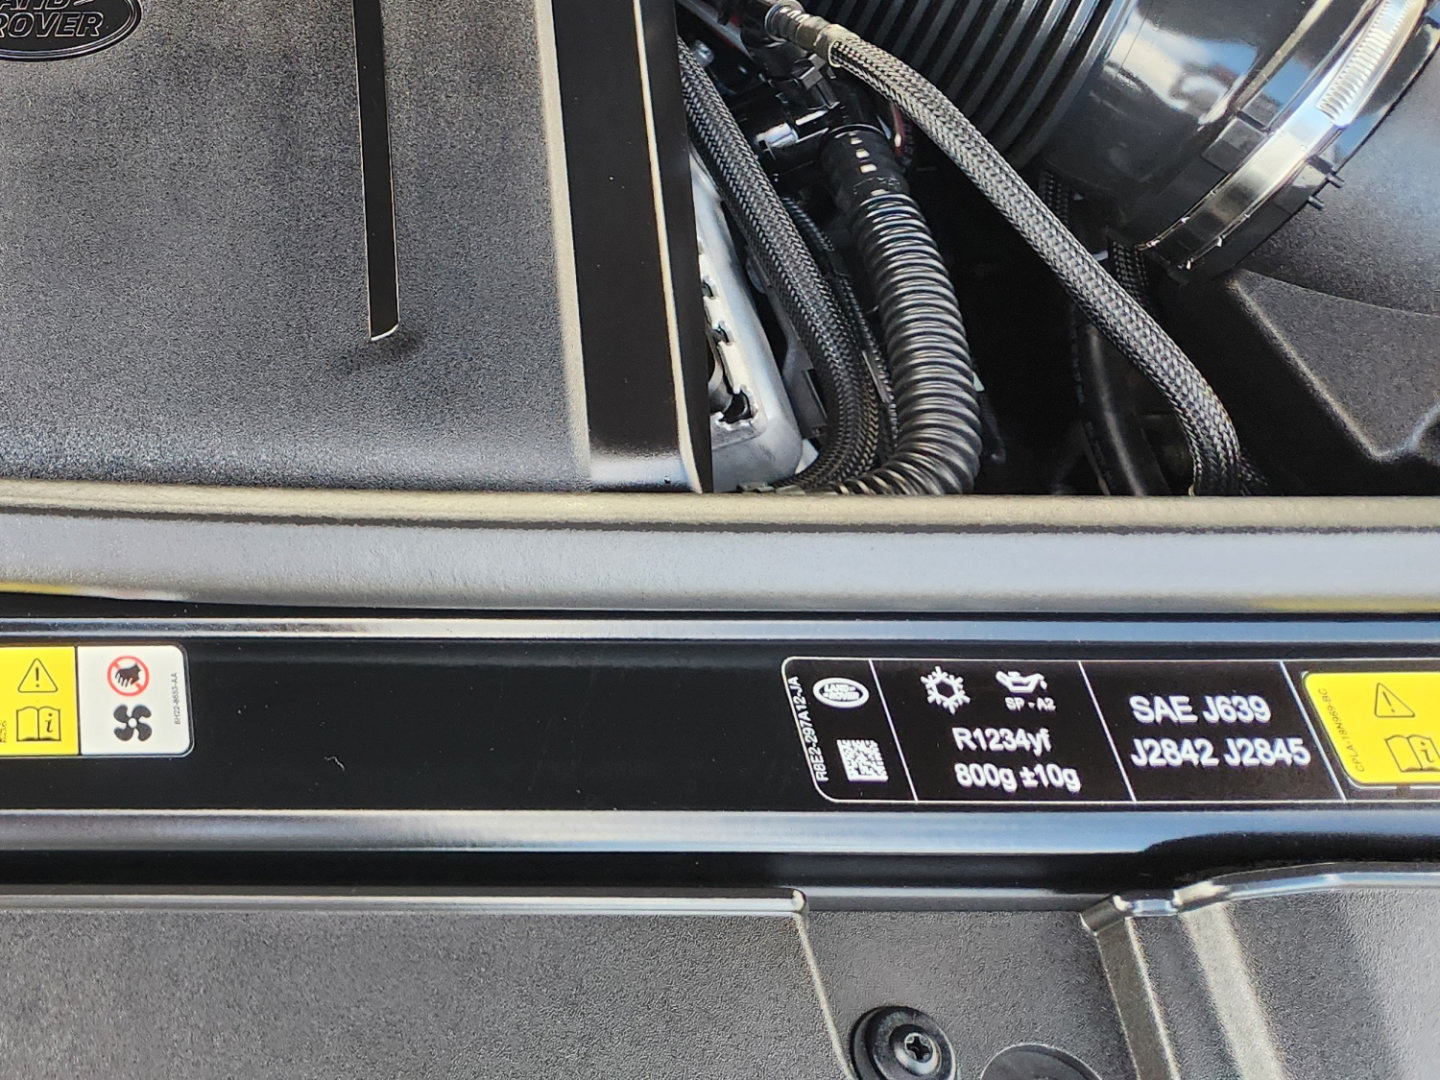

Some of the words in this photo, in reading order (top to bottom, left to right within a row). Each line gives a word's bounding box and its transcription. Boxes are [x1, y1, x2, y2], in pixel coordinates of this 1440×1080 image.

[1129, 695, 1198, 724] SAE
[1202, 695, 1271, 724] J639
[951, 727, 1052, 757] R1234yf
[1130, 738, 1220, 767] J2842
[1223, 737, 1311, 766] J2845
[954, 763, 1017, 793] 800g
[1019, 763, 1082, 793] ±10g
